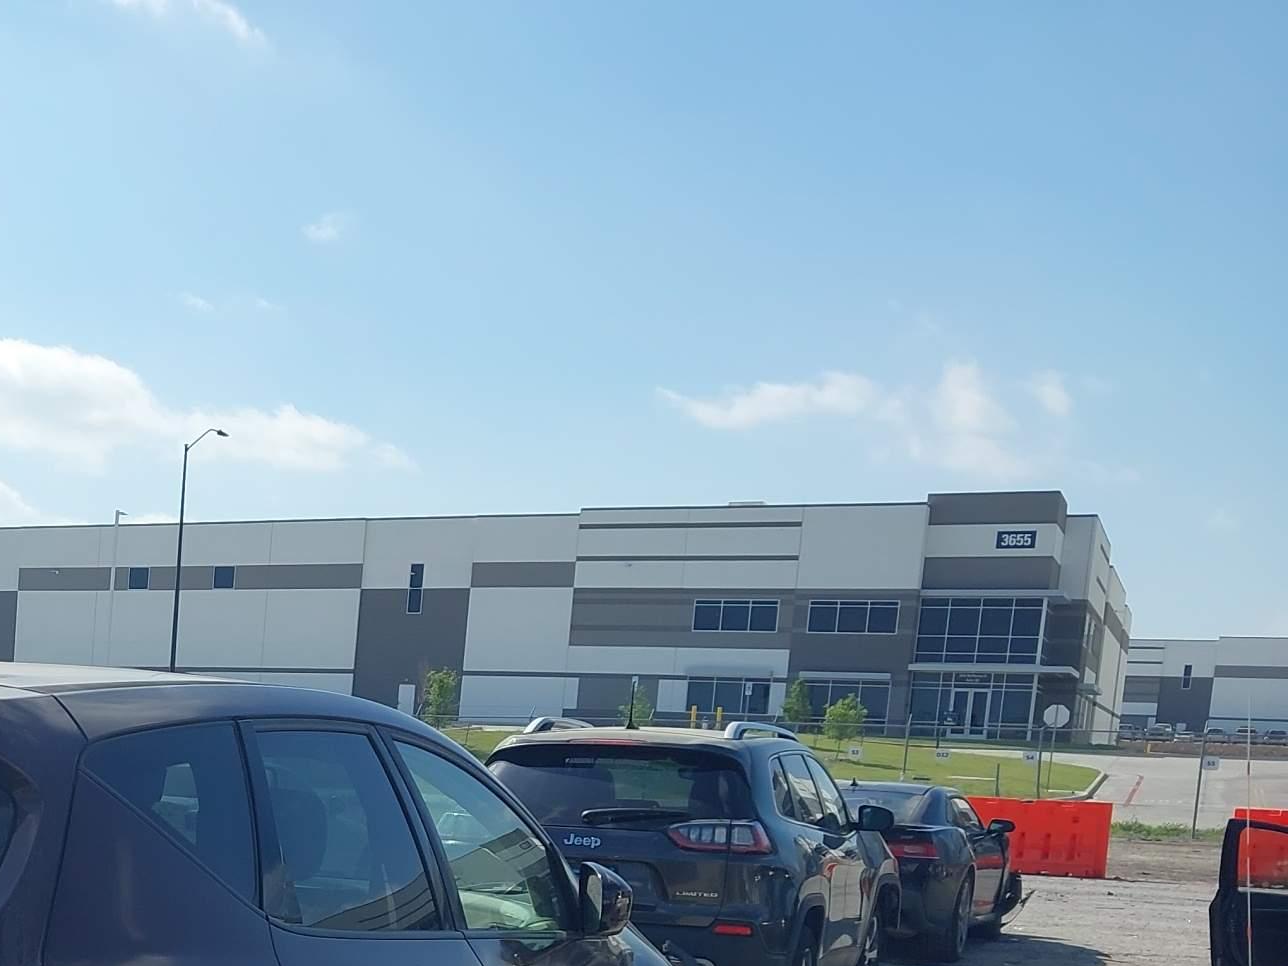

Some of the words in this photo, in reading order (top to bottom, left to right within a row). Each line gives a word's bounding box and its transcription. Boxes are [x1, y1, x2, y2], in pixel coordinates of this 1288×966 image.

[1001, 533, 1033, 546] 3655
[564, 833, 601, 849] Jeep
[675, 890, 719, 898] LIMITED
